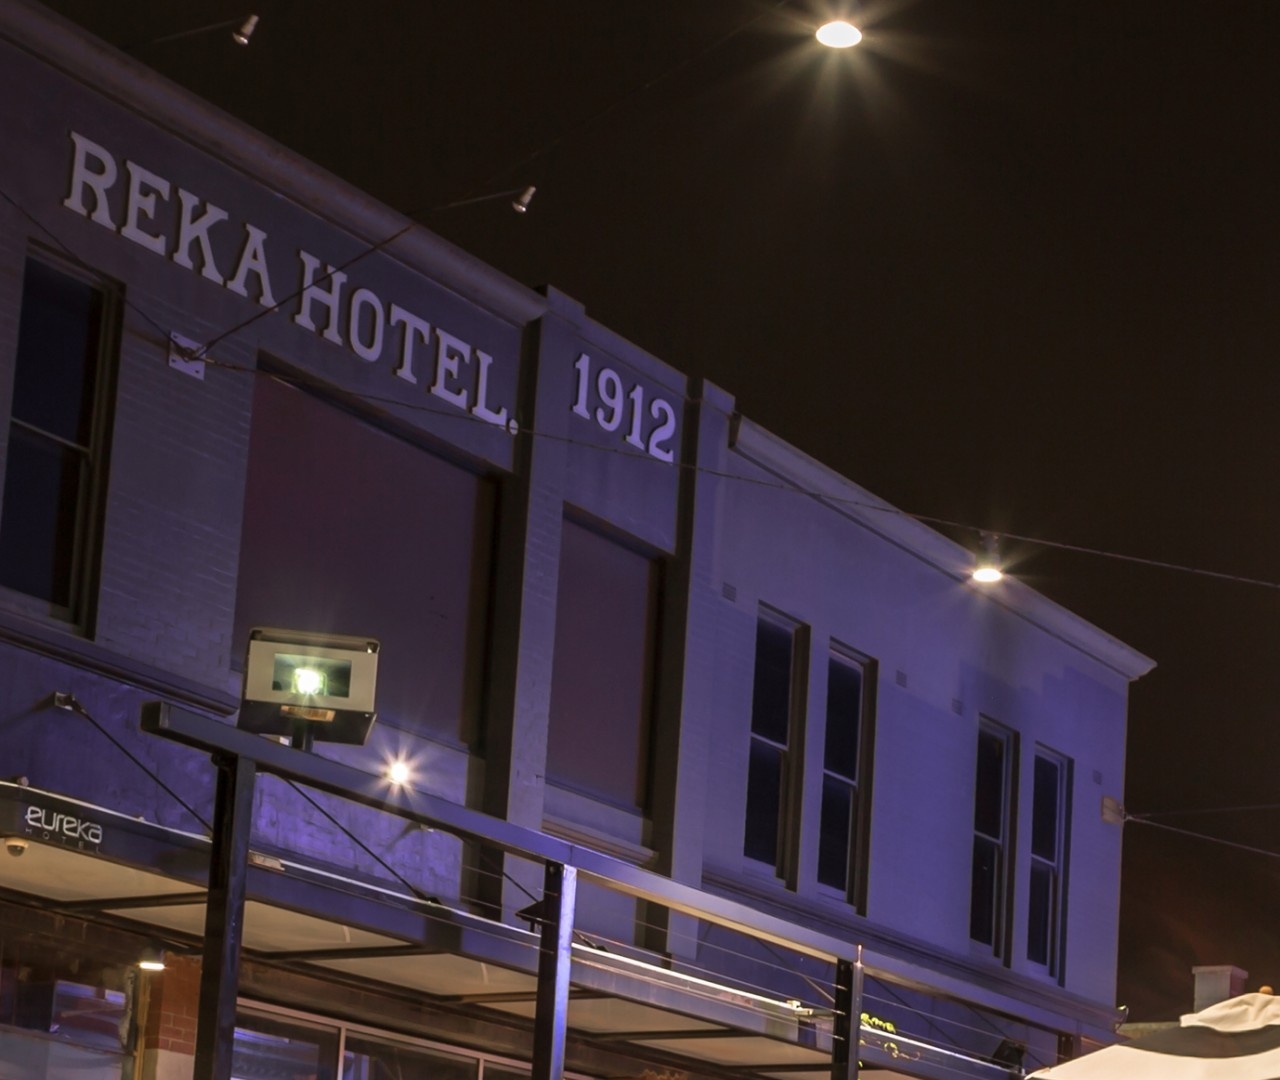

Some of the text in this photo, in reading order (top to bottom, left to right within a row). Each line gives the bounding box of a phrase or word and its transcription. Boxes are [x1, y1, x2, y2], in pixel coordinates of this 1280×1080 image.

[63, 130, 279, 312] REKA
[572, 352, 675, 463] 1912
[25, 806, 102, 844] eureka
